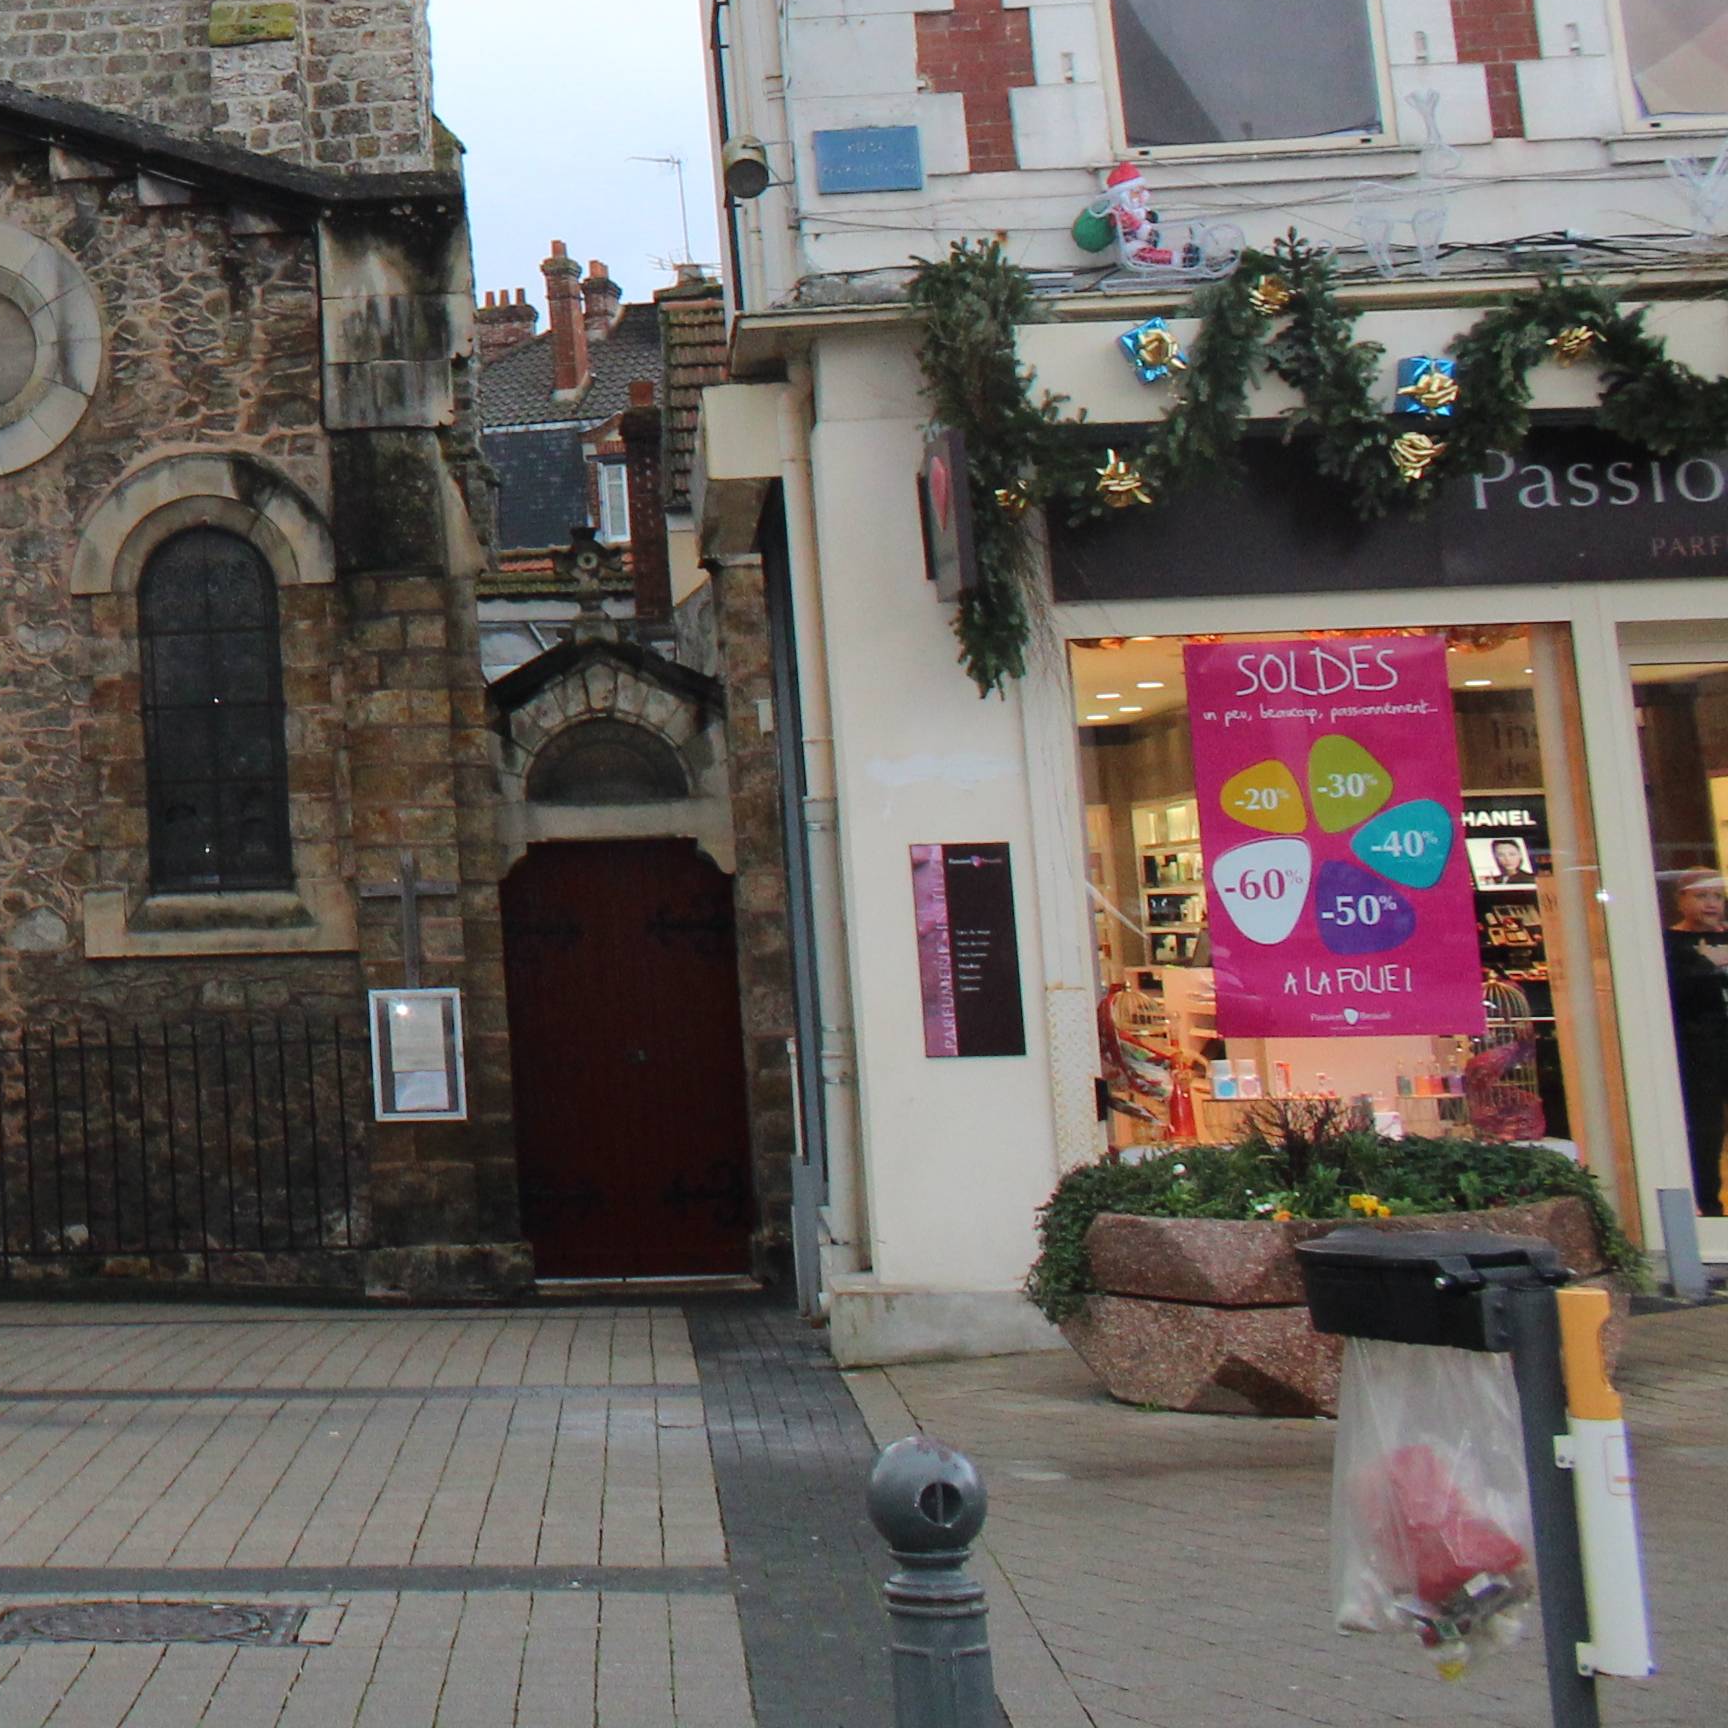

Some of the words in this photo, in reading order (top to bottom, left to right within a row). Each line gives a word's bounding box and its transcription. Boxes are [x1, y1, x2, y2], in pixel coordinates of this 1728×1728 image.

[1650, 534, 1728, 558] PARF
[1236, 645, 1399, 696] SOLDES
[1461, 810, 1537, 827] HANEL
[1370, 830, 1439, 858] -40%
[1224, 868, 1304, 901] -60%
[1321, 894, 1398, 927] -50%
[1284, 971, 1298, 995] A
[1306, 966, 1332, 995] LA
